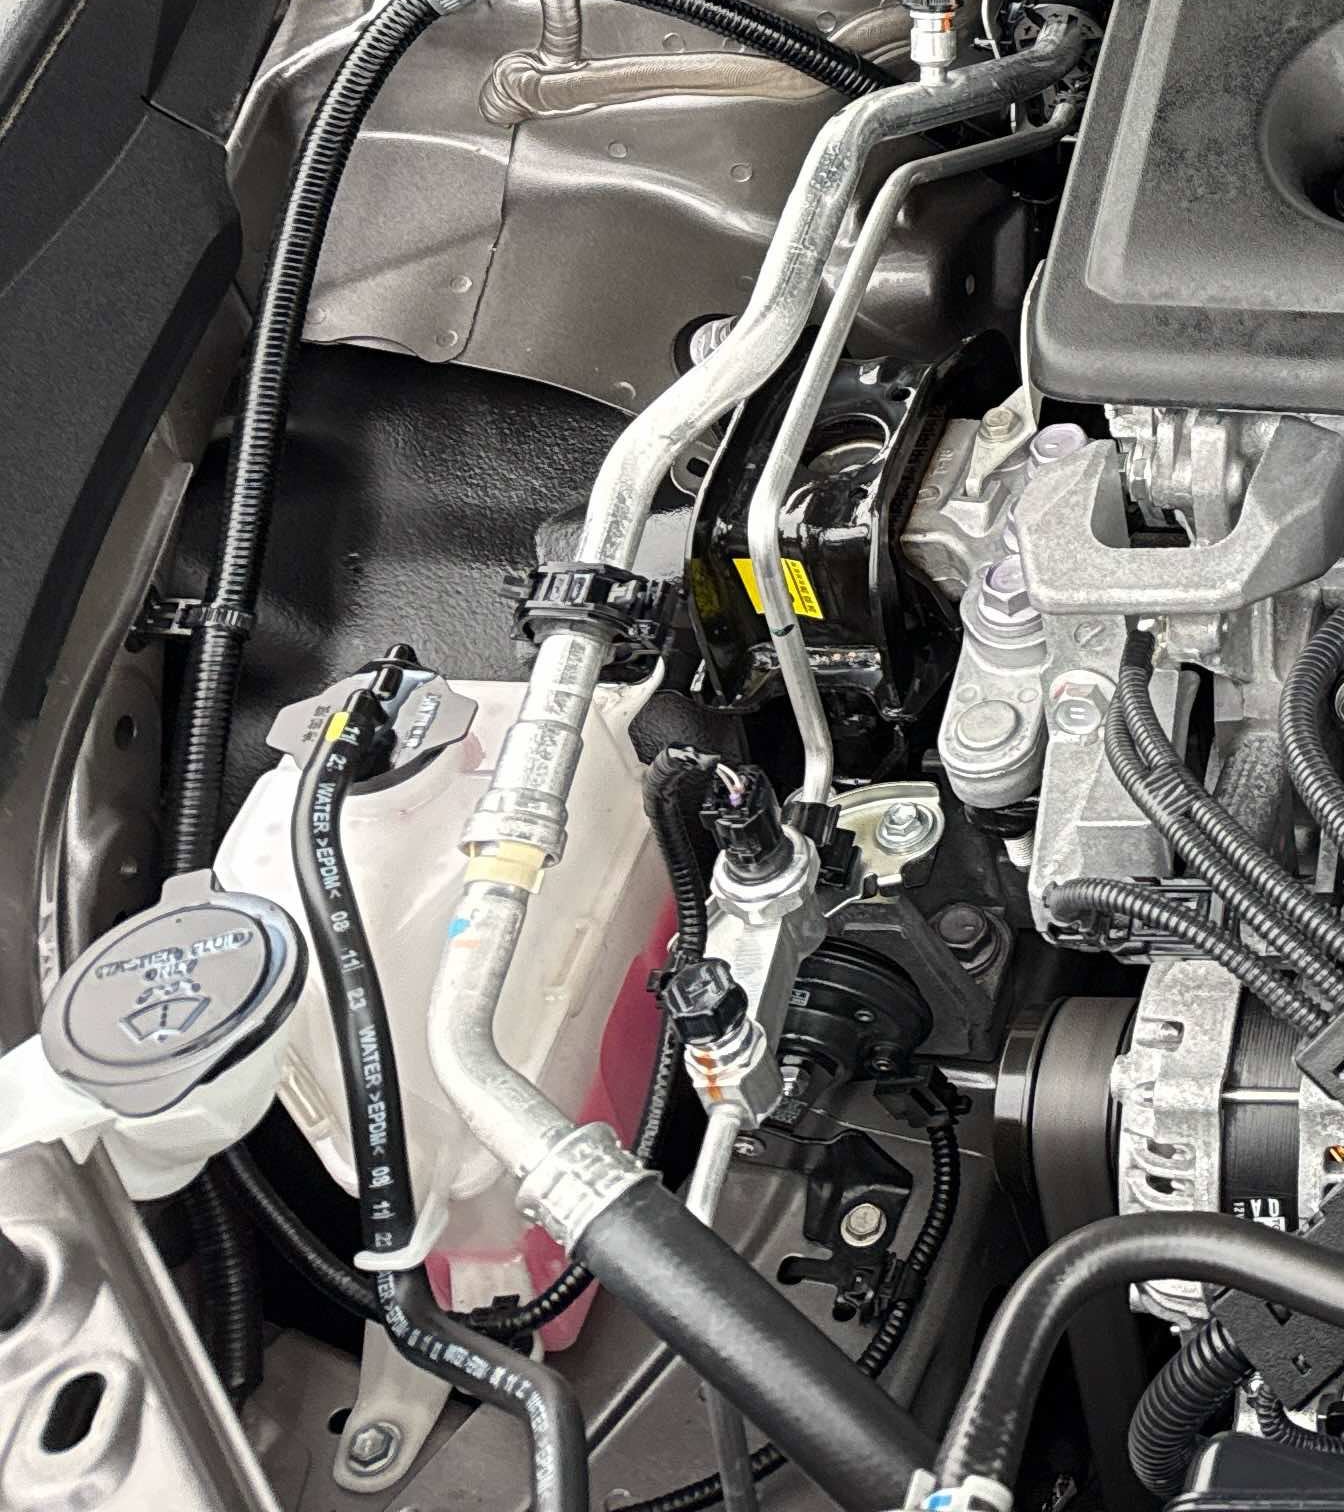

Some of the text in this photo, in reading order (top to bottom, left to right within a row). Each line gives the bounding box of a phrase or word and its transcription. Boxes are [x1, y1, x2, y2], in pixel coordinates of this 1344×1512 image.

[313, 782, 337, 834] WATER
[330, 910, 350, 933] 08
[358, 1024, 383, 1089] WATER
